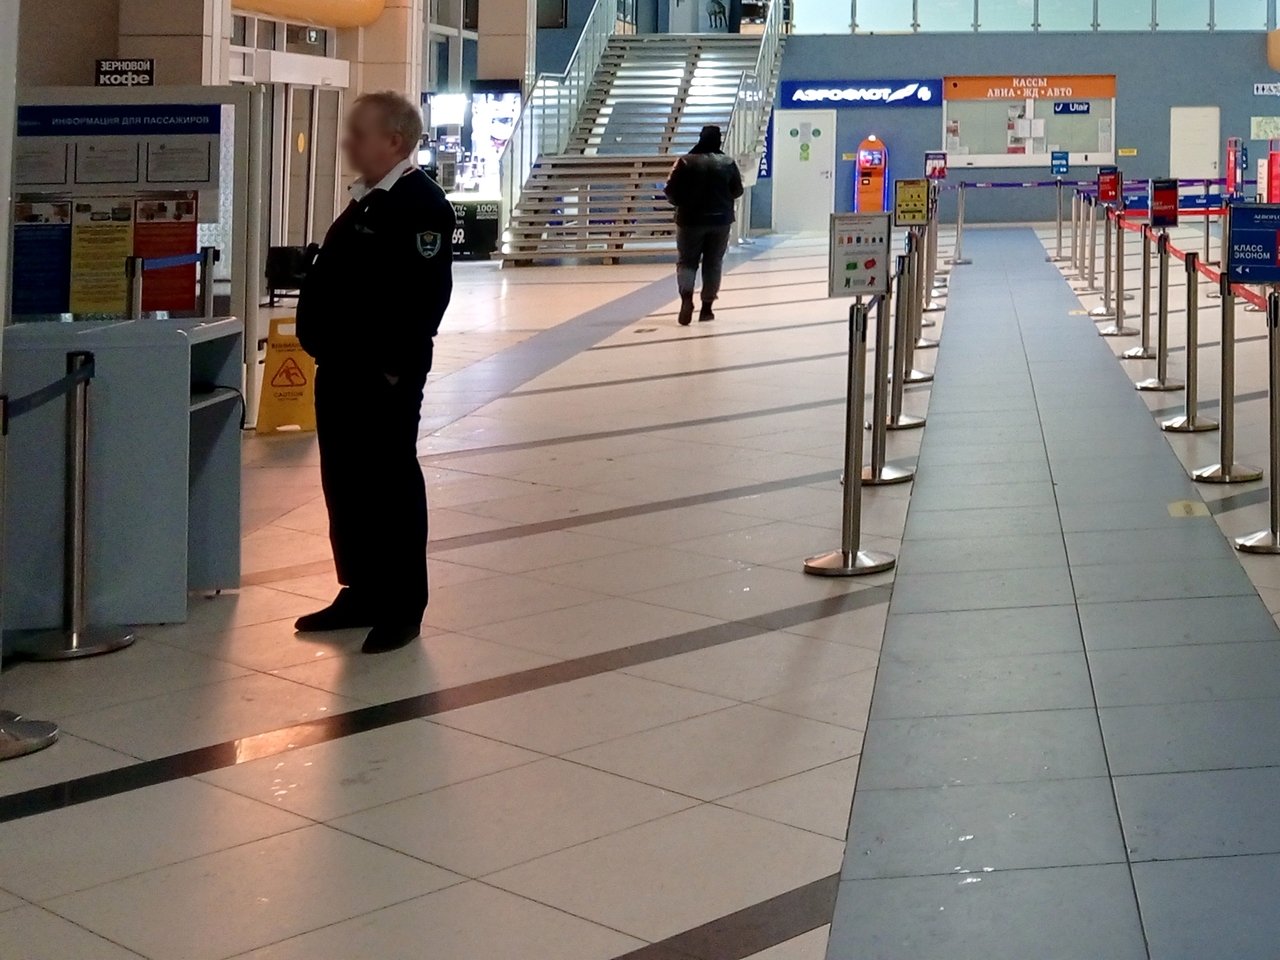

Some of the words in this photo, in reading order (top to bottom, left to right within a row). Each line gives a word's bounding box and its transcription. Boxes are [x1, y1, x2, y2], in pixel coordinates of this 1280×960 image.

[100, 60, 150, 72] ЗЕРНОВОЙ
[100, 72, 150, 86] кофе
[1012, 78, 1048, 88] КАССЫ
[792, 88, 891, 102] АЭРОФЛОТ
[987, 88, 1015, 98] АВИА
[1023, 88, 1039, 99] ЖД
[1046, 88, 1072, 97] АВТО
[52, 117, 120, 126] ИНФОРМАЦИЯ
[122, 117, 141, 126] ДЛЯ
[143, 116, 210, 124] ПАССАЖИРОВ
[476, 204, 498, 212] 100%
[1234, 244, 1263, 252] КЛАСС
